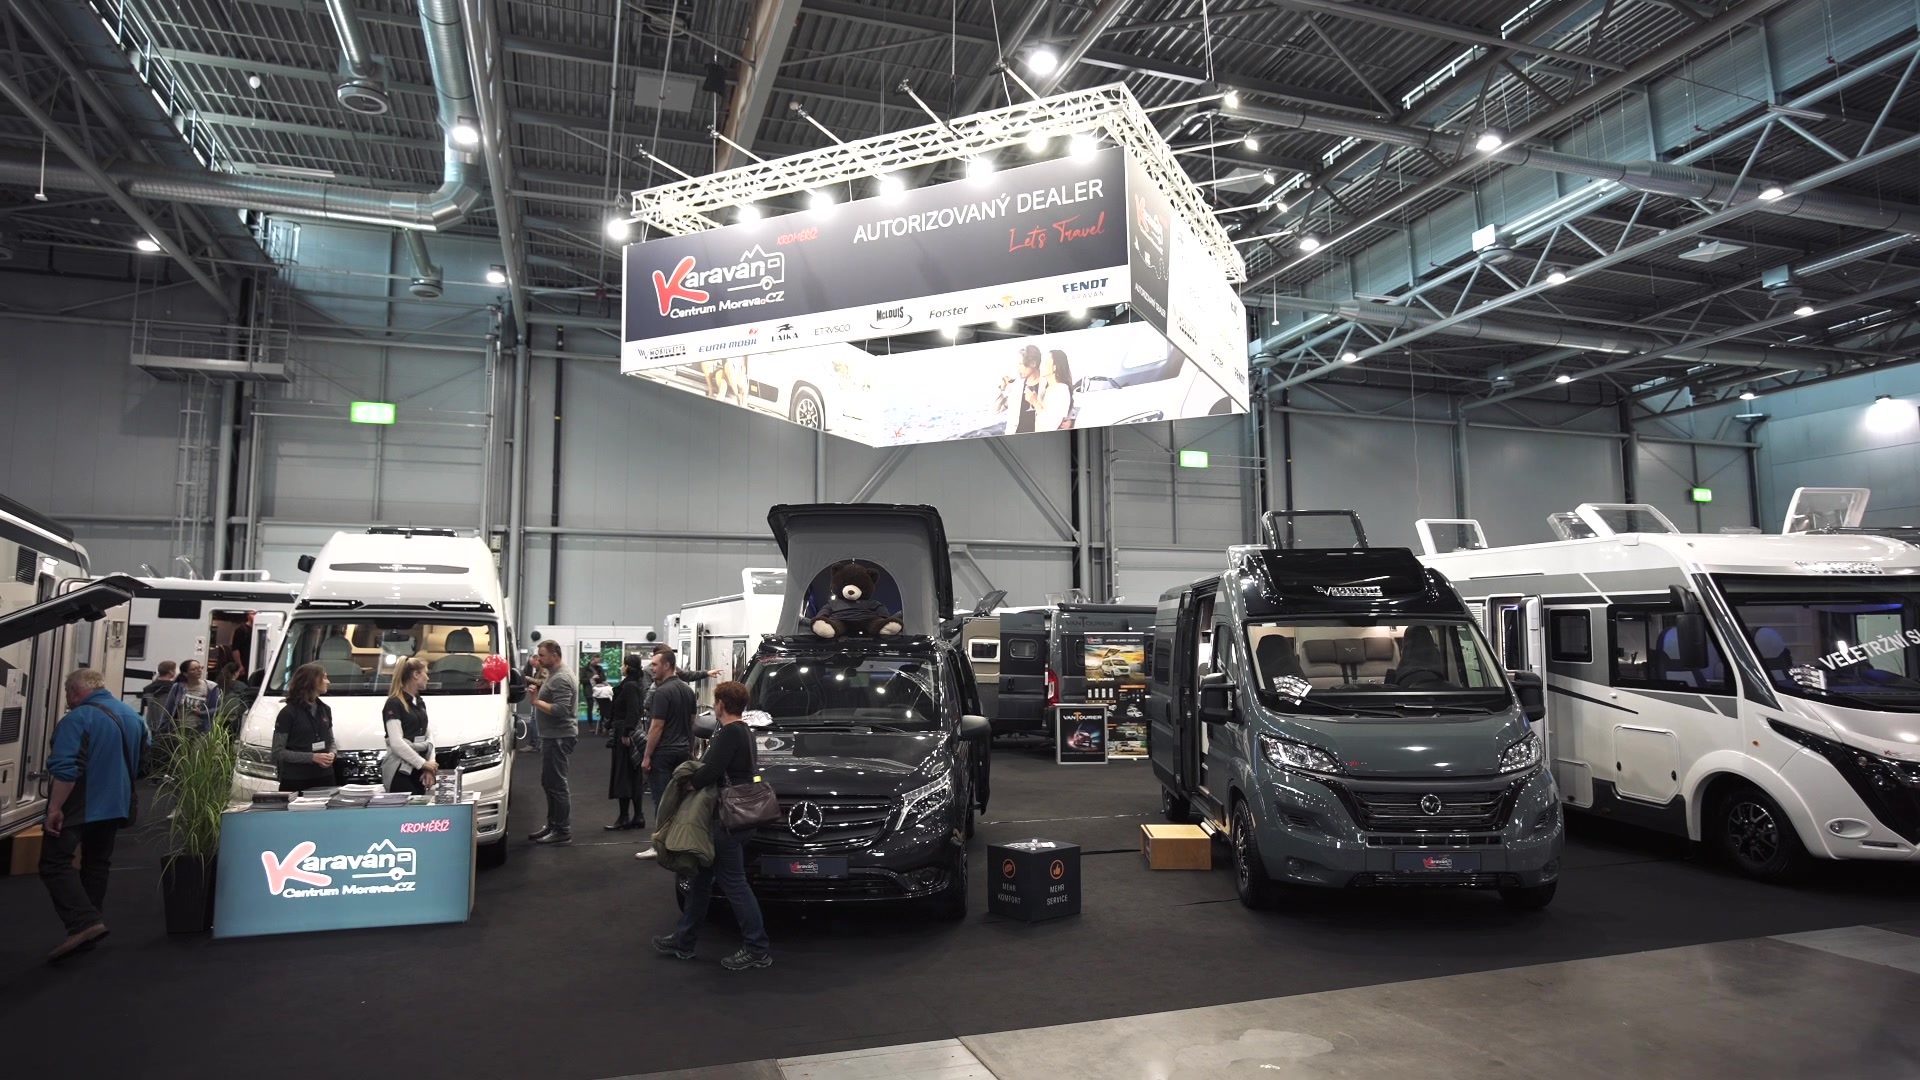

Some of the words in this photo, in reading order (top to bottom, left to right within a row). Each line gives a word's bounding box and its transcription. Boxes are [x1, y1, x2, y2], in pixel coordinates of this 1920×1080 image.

[853, 194, 1010, 244] AUTORIZOVANÝ
[1017, 178, 1104, 214] DEALER
[1052, 211, 1105, 243] Travel
[1062, 278, 1109, 294] FENDT
[1065, 291, 1105, 302] CARAVAN
[670, 303, 717, 319] Centrum
[929, 305, 969, 320] Forster
[771, 332, 799, 343] LAIKA
[699, 342, 727, 353] EURA
[728, 338, 758, 350] MOBIL
[1818, 629, 1911, 671] VELETRŽNÍ
[282, 886, 340, 899] Centrum
[1002, 882, 1017, 892] MEHR
[1049, 883, 1065, 893] MEHR
[997, 893, 1021, 905] KOMFORT
[1046, 895, 1068, 905] SERVICE
